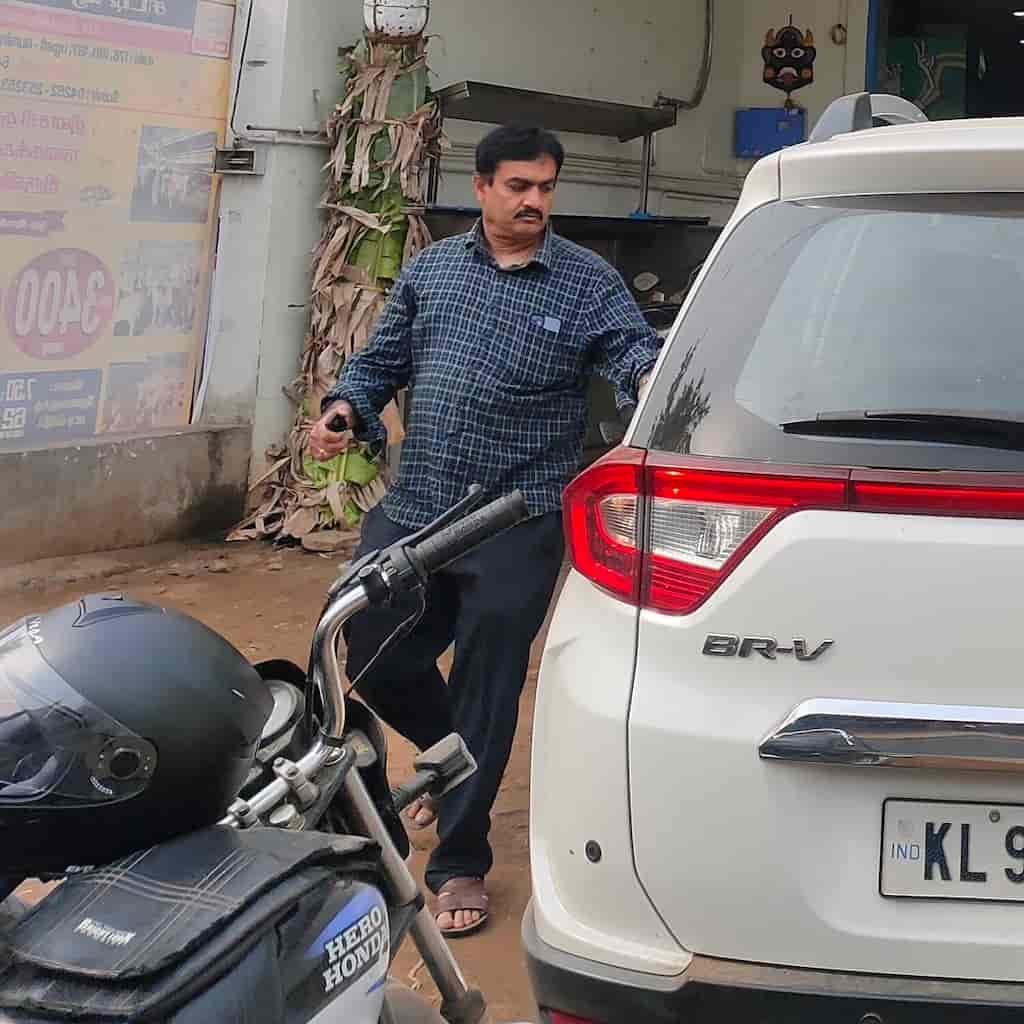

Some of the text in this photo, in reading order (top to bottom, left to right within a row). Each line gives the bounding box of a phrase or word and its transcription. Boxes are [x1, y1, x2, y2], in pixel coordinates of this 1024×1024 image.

[702, 633, 834, 661] BR-V
[890, 841, 920, 861] IND
[923, 821, 988, 883] KL
[325, 906, 382, 964] HERO
